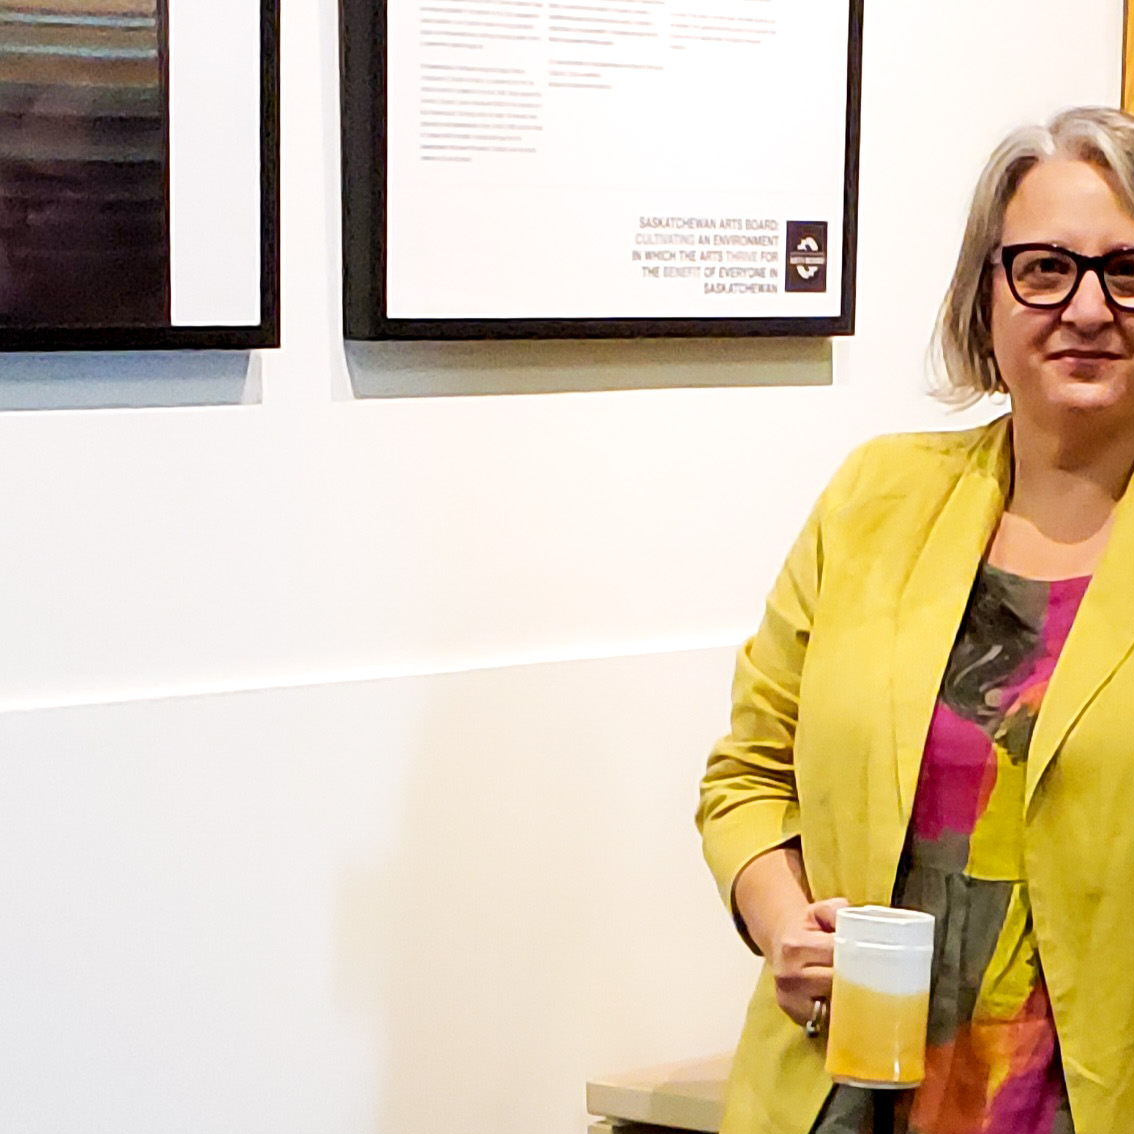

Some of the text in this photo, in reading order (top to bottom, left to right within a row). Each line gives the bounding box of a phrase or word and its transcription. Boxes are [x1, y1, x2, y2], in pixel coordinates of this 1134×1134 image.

[639, 217, 716, 229] SASKATCHEWAN
[719, 218, 742, 230] ARTS
[635, 233, 779, 246] CULTIVATING AN ENVIRONMENT
[632, 251, 641, 261] IN
[645, 251, 676, 261] WHICH
[679, 251, 696, 261] THE
[700, 251, 723, 262] ARTS
[761, 251, 778, 262] FOR
[642, 266, 659, 277] THE
[704, 267, 716, 277] OF
[719, 267, 766, 278] EVERYONE
[770, 268, 778, 277] IN
[704, 283, 777, 294] SASKATCHEWAN
